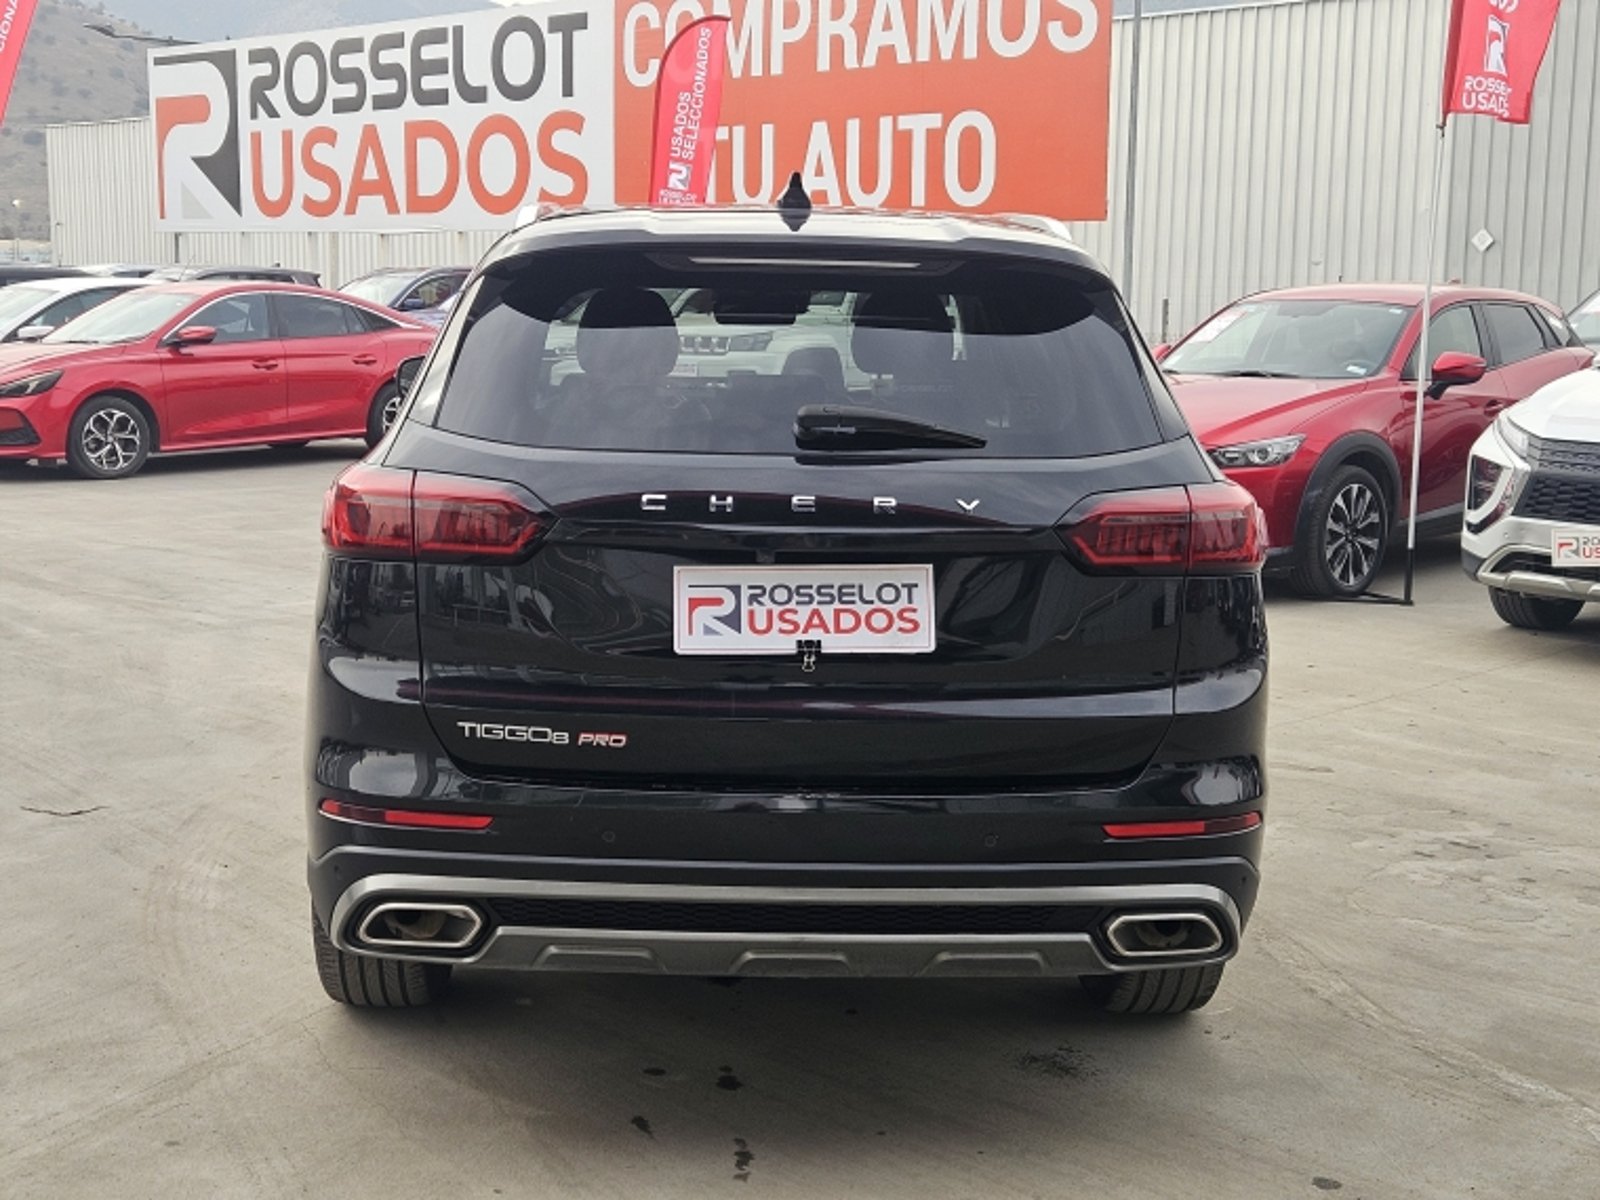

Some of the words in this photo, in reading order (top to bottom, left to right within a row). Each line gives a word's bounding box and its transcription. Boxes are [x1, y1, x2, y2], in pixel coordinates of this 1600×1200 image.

[248, 12, 589, 120] ROSSELOT
[681, 27, 712, 160] SELECCIONADOS
[670, 91, 691, 157] USADOS
[250, 109, 590, 218] USADOS
[800, 110, 997, 208] AUTO
[641, 494, 980, 514] CHERY
[747, 583, 919, 606] ROSSELOT
[747, 607, 920, 635] USADOS
[577, 732, 628, 748] PRO
